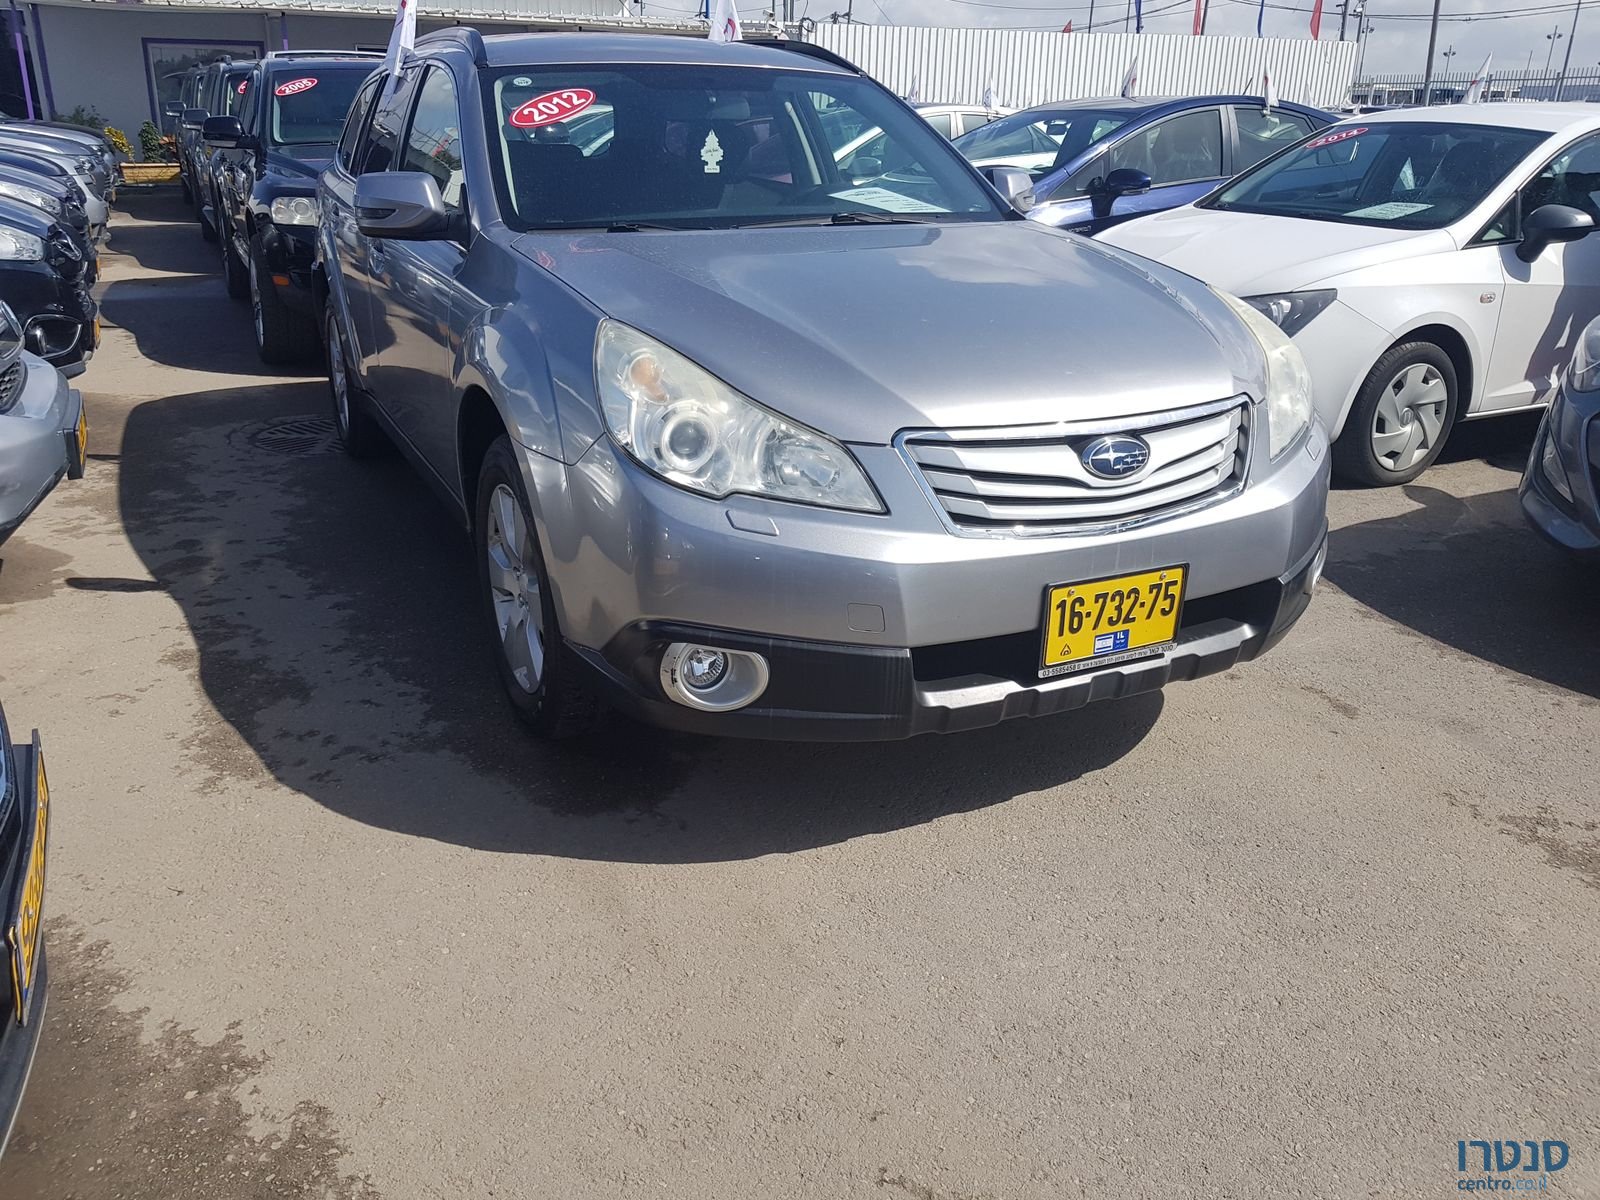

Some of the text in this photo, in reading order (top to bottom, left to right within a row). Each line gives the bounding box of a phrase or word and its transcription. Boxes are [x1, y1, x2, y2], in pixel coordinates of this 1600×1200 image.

[281, 79, 312, 95] 2005
[522, 91, 587, 122] 2012
[1055, 579, 1179, 638] 16-732-75
[1116, 631, 1126, 640] IL
